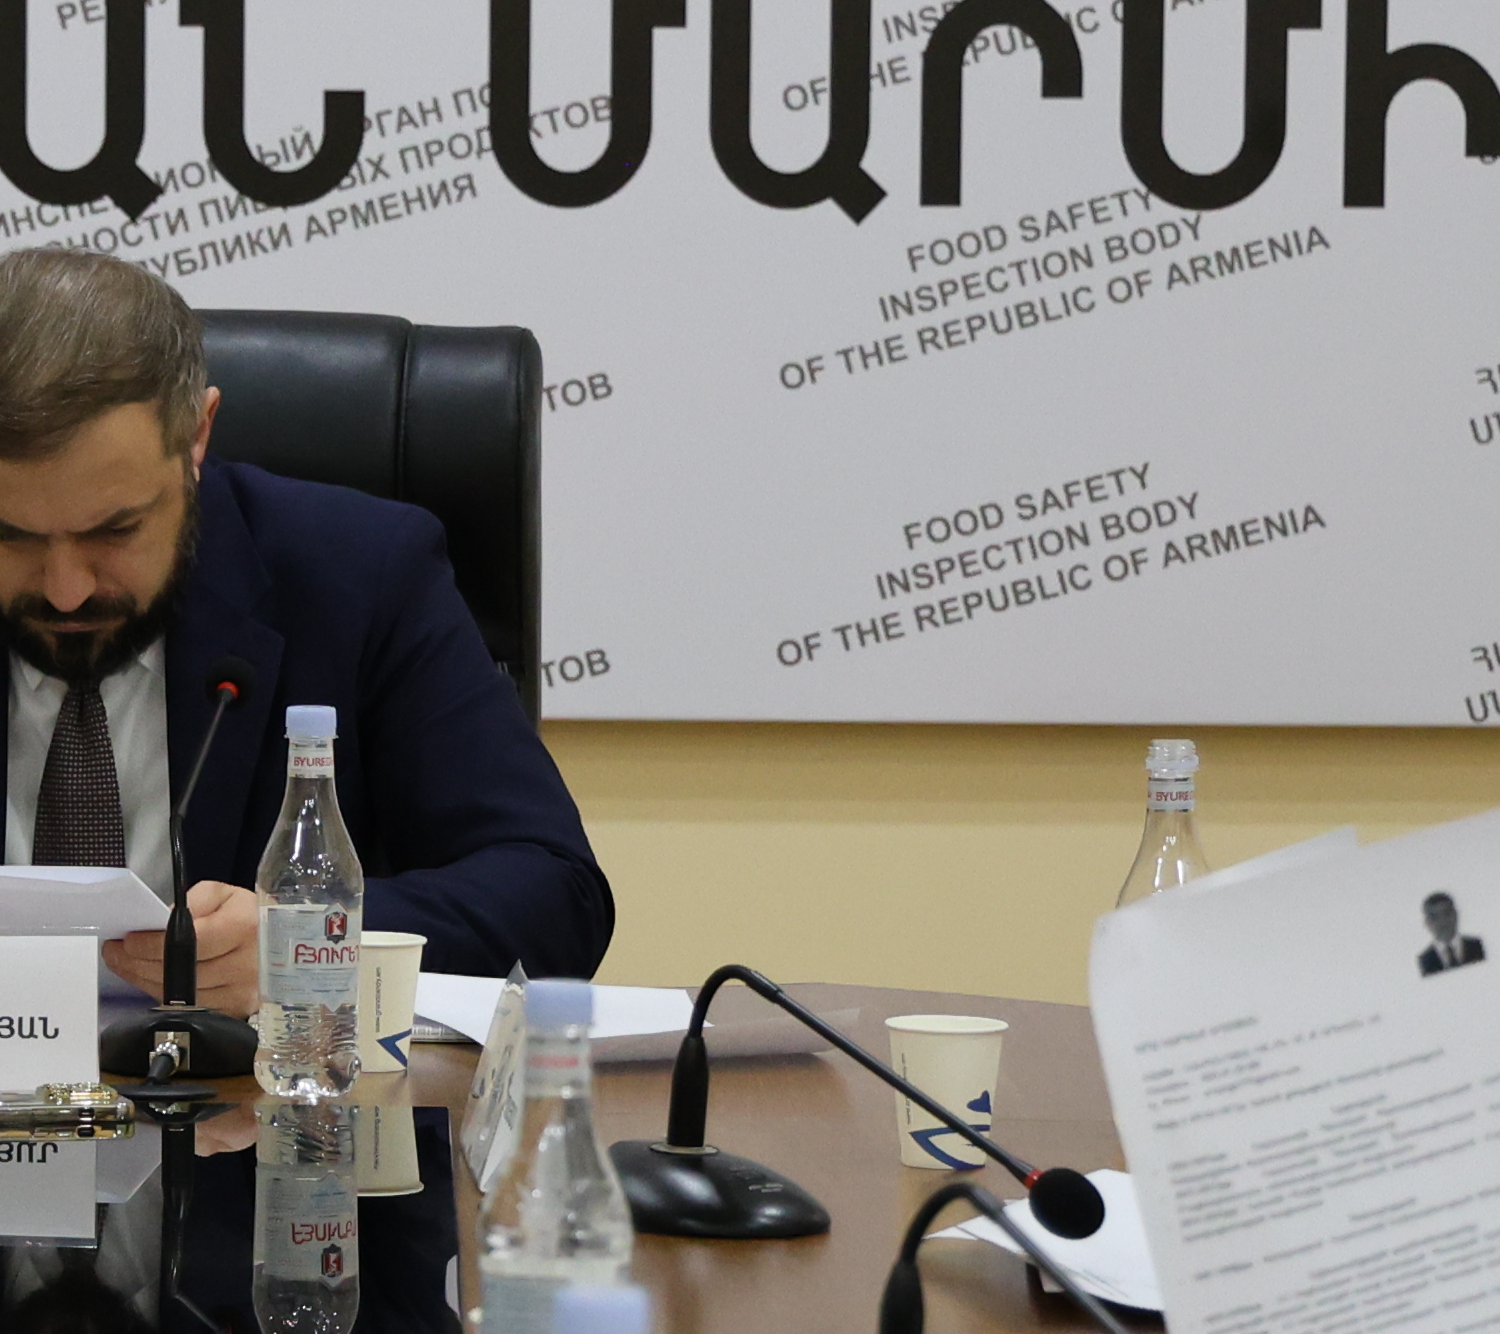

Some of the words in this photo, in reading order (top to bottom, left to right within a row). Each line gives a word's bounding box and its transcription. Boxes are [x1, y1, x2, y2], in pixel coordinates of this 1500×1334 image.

[879, 243, 1094, 322] INSPECTION
[1104, 215, 1200, 263] BODY
[907, 225, 1007, 273] FOOD
[1018, 188, 1150, 242] SAFETY
[780, 355, 824, 390] OF
[835, 334, 908, 374] THE
[917, 286, 1095, 355] REPUBLIC
[1107, 269, 1152, 304] OF
[1167, 226, 1330, 291] ARMENIA
